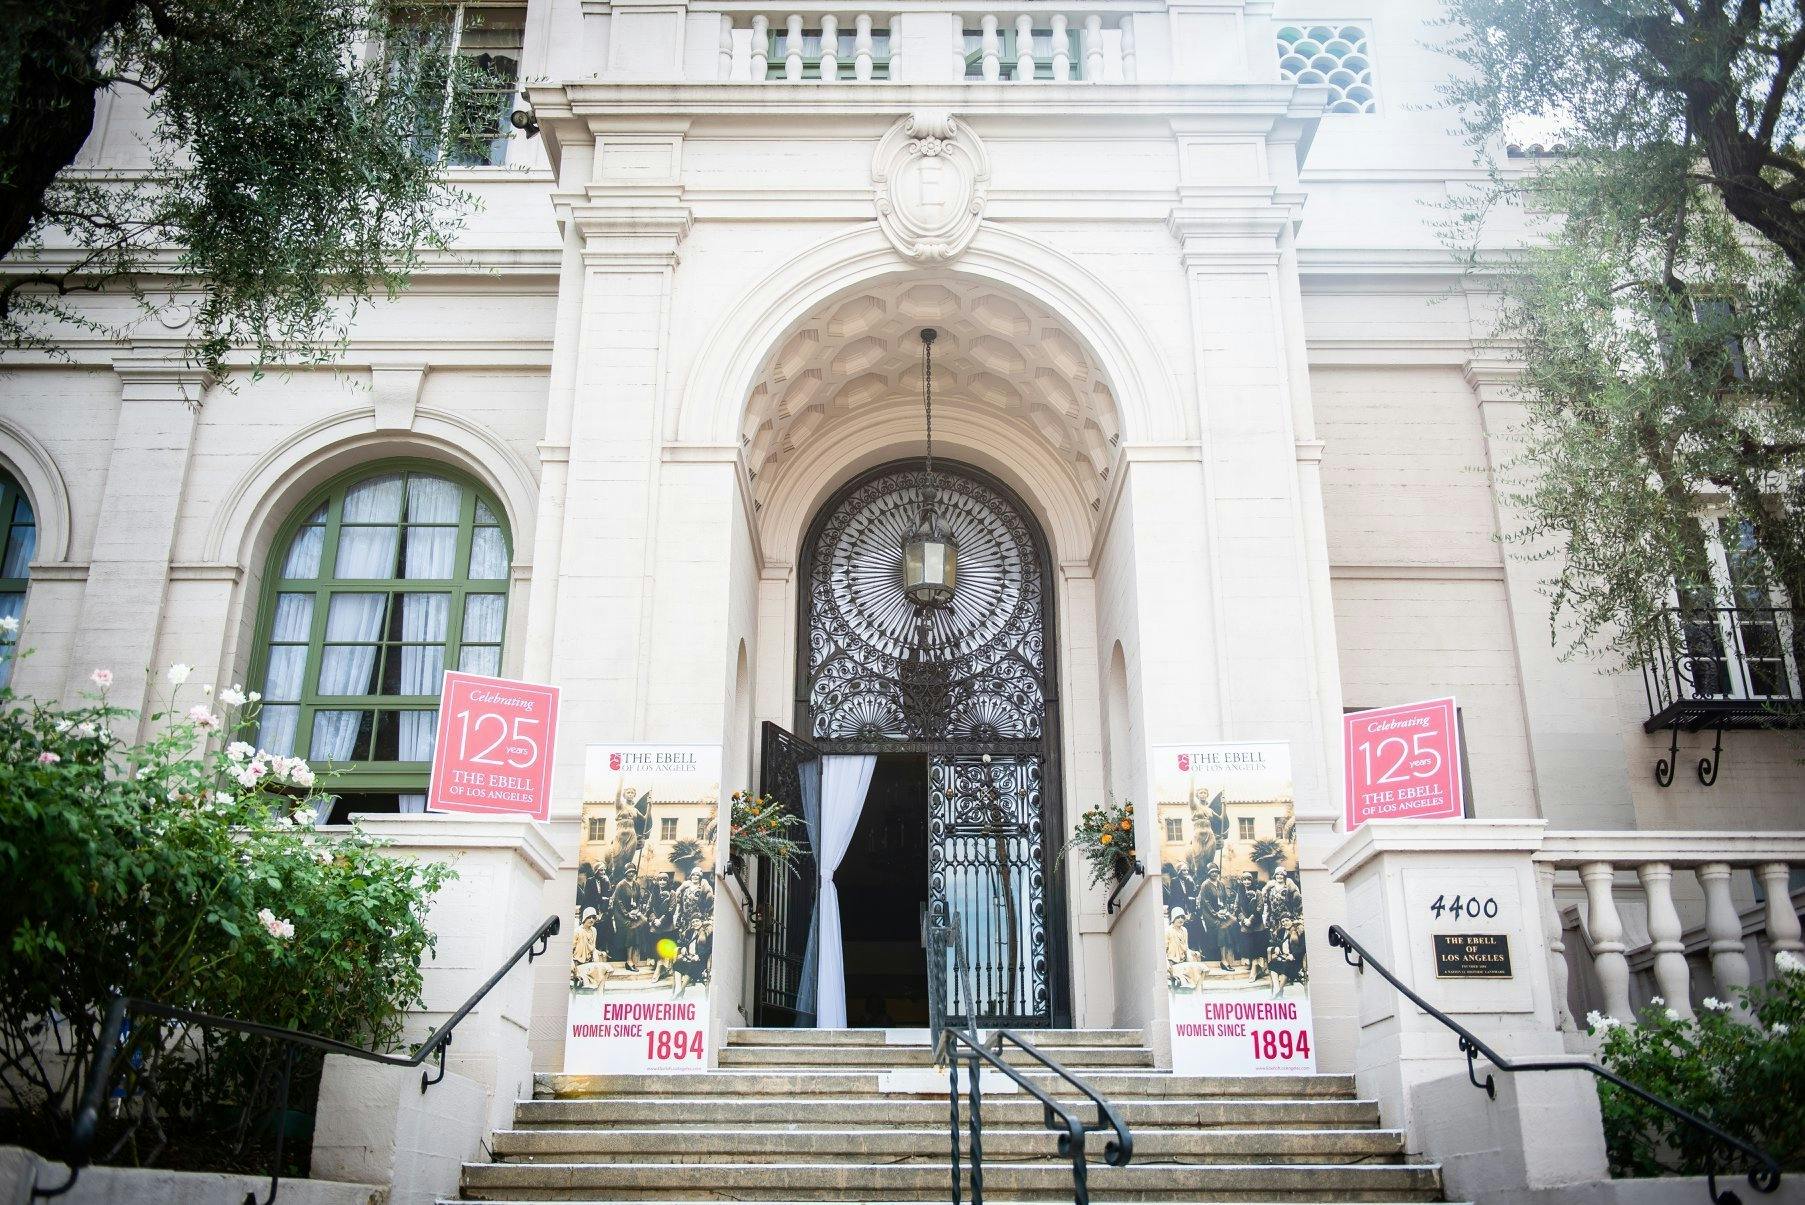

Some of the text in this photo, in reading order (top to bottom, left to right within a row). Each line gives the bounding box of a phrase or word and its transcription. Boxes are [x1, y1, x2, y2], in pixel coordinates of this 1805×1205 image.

[917, 167, 946, 207] E
[470, 689, 535, 712] Celebrating
[1367, 716, 1431, 733] Celebrating
[457, 709, 539, 768] 125
[505, 746, 529, 756] years
[622, 752, 697, 764] THE EBELL
[1190, 752, 1266, 764] THE EBELL
[1359, 731, 1441, 786] 125
[621, 764, 697, 772] OF LOS ANGELES
[1409, 758, 1432, 769] years
[452, 769, 535, 791] THE EBELL
[449, 785, 534, 803] OF LOS ANGELES
[1362, 784, 1443, 805] THE EBELL
[1362, 796, 1444, 816] OF LOS ANGELES
[1430, 894, 1498, 922] 4400
[1445, 937, 1497, 945] THE EBELL
[1465, 945, 1478, 953] OF
[1441, 954, 1505, 962] LOS ANGELES
[603, 1003, 696, 1021] EMPOWERING
[1204, 1002, 1297, 1021] EMPOWERING
[572, 1024, 704, 1060] WOMEN SINCE 1894
[1176, 1023, 1310, 1060] WOMEN SINCE 1894
